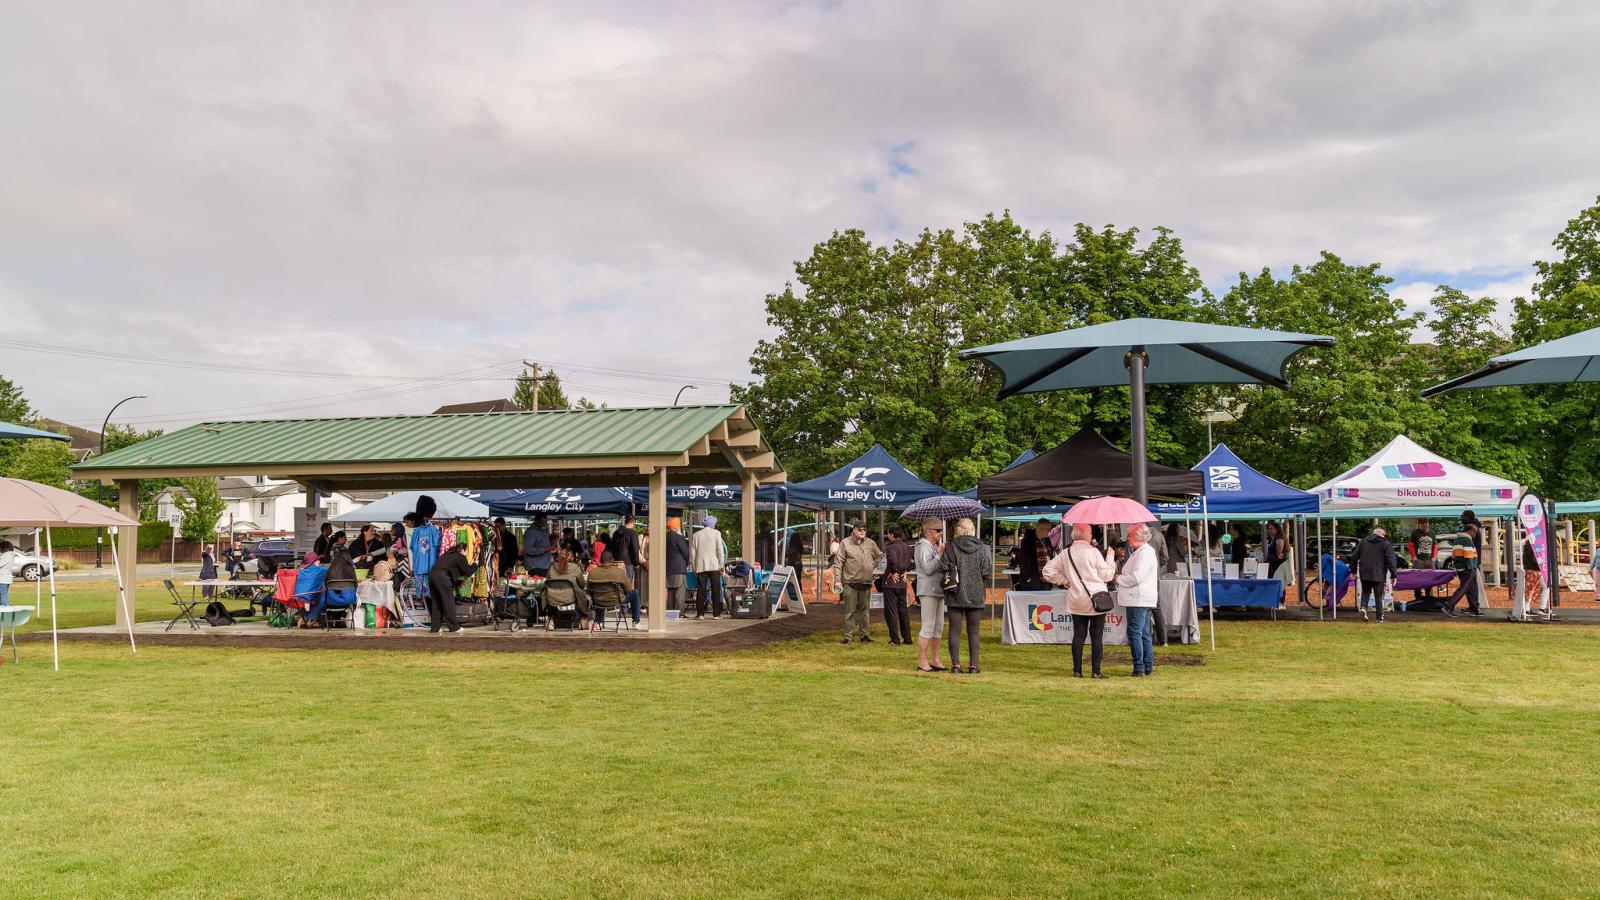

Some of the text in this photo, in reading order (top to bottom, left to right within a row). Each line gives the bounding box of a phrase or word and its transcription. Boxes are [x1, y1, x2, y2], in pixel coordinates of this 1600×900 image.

[671, 488, 734, 499] Langley City
[828, 489, 896, 502] Langley City
[1397, 489, 1451, 497] bikehub.ca
[525, 501, 584, 512] Langley City
[1105, 613, 1123, 626] ity
